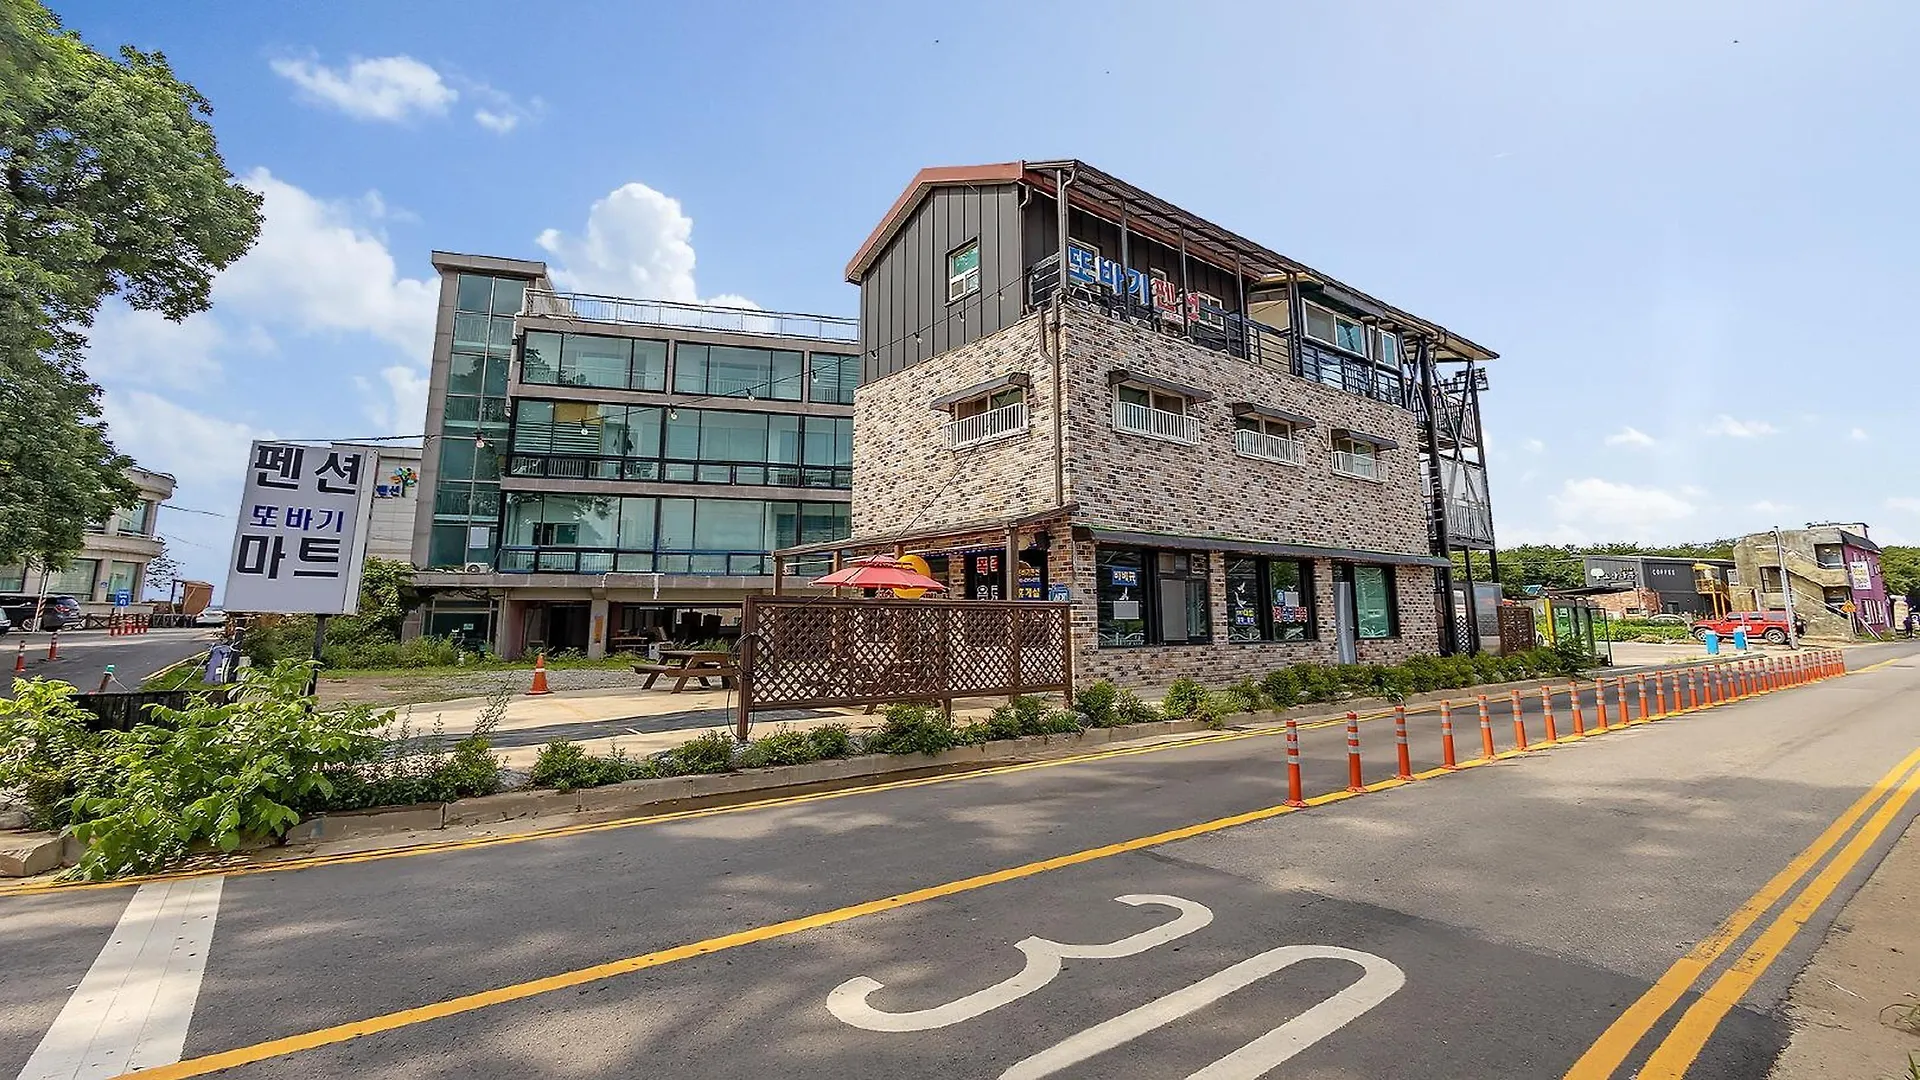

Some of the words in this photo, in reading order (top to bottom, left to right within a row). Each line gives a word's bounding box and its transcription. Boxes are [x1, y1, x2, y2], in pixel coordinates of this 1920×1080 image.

[1068, 245, 1149, 306] 또바기
[254, 445, 361, 495] 펜션
[249, 504, 344, 533] 또바기
[236, 534, 341, 580] 마트
[1652, 568, 1676, 576] COFFEE
[826, 894, 1406, 1080] 30
